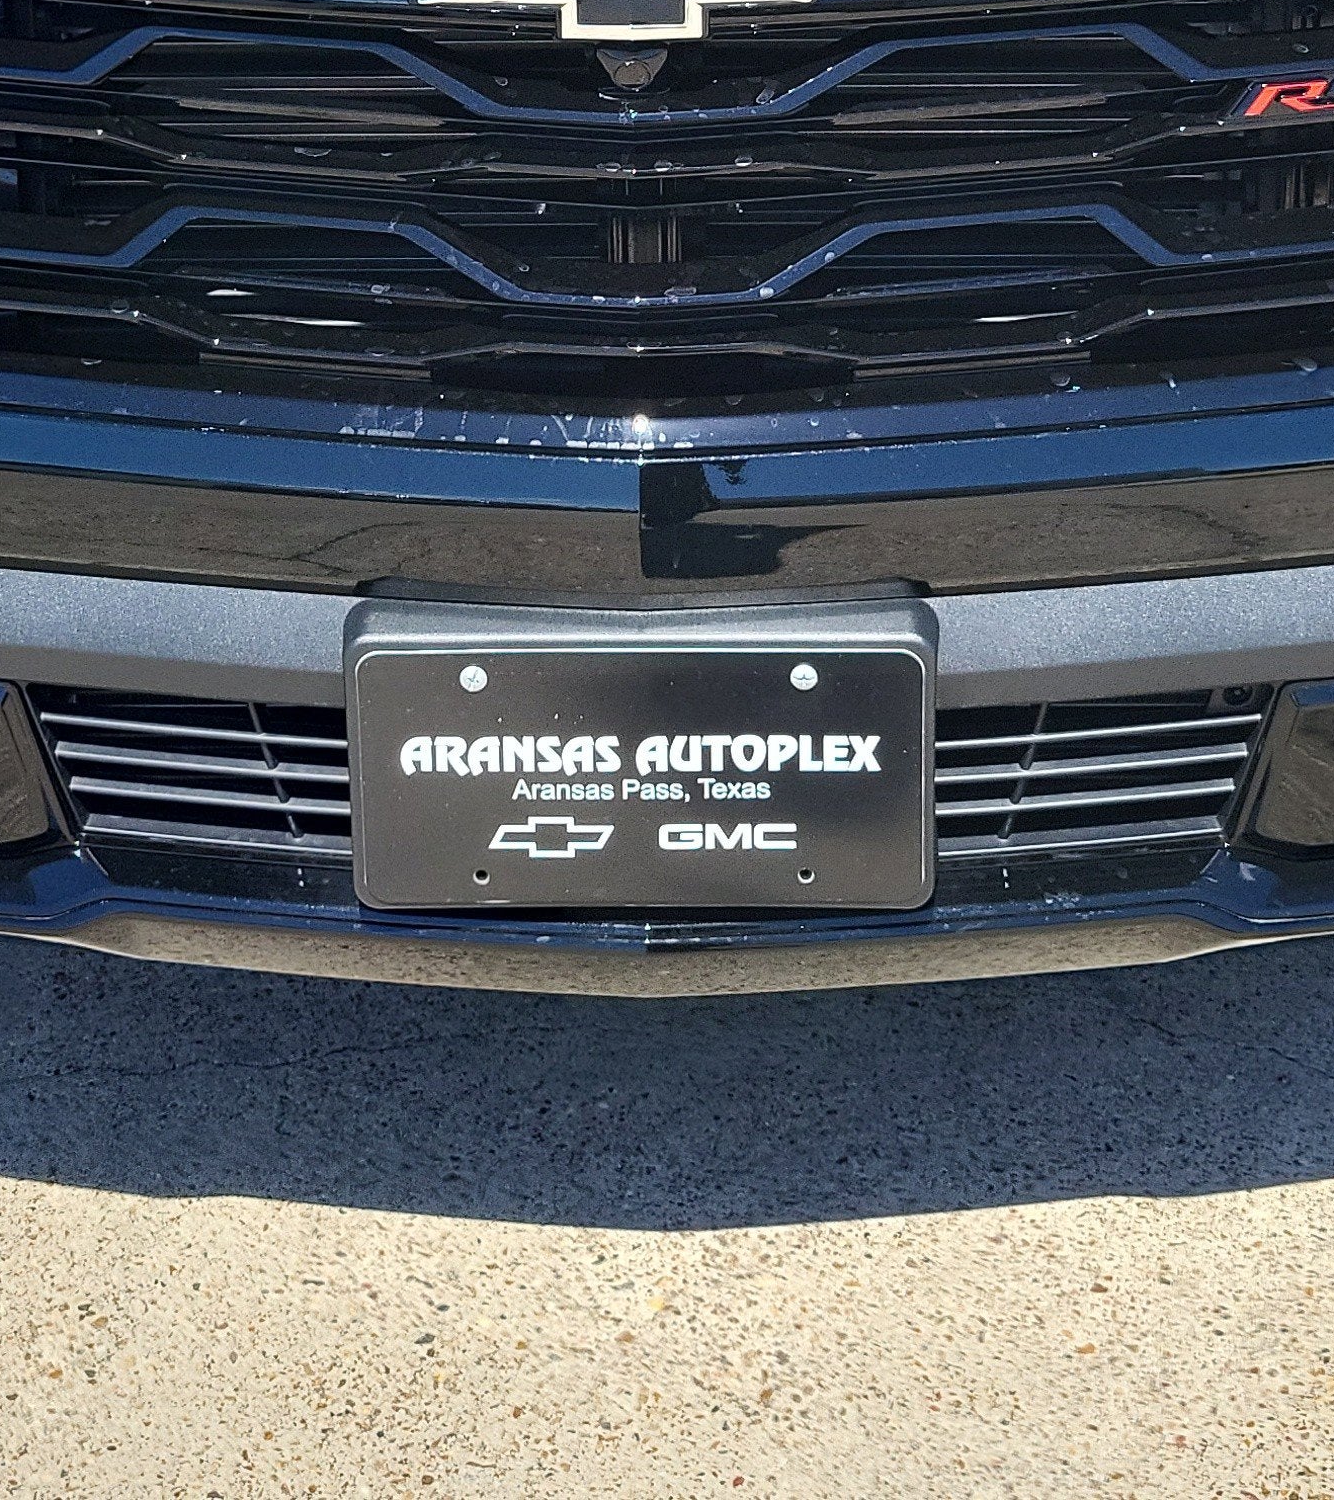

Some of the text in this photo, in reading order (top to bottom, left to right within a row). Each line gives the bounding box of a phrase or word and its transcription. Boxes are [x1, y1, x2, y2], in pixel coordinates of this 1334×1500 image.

[400, 734, 882, 776] ARANSAS AUTOPLEX
[511, 777, 772, 803] Aransas Pass, Texas
[658, 822, 798, 850] GMC
